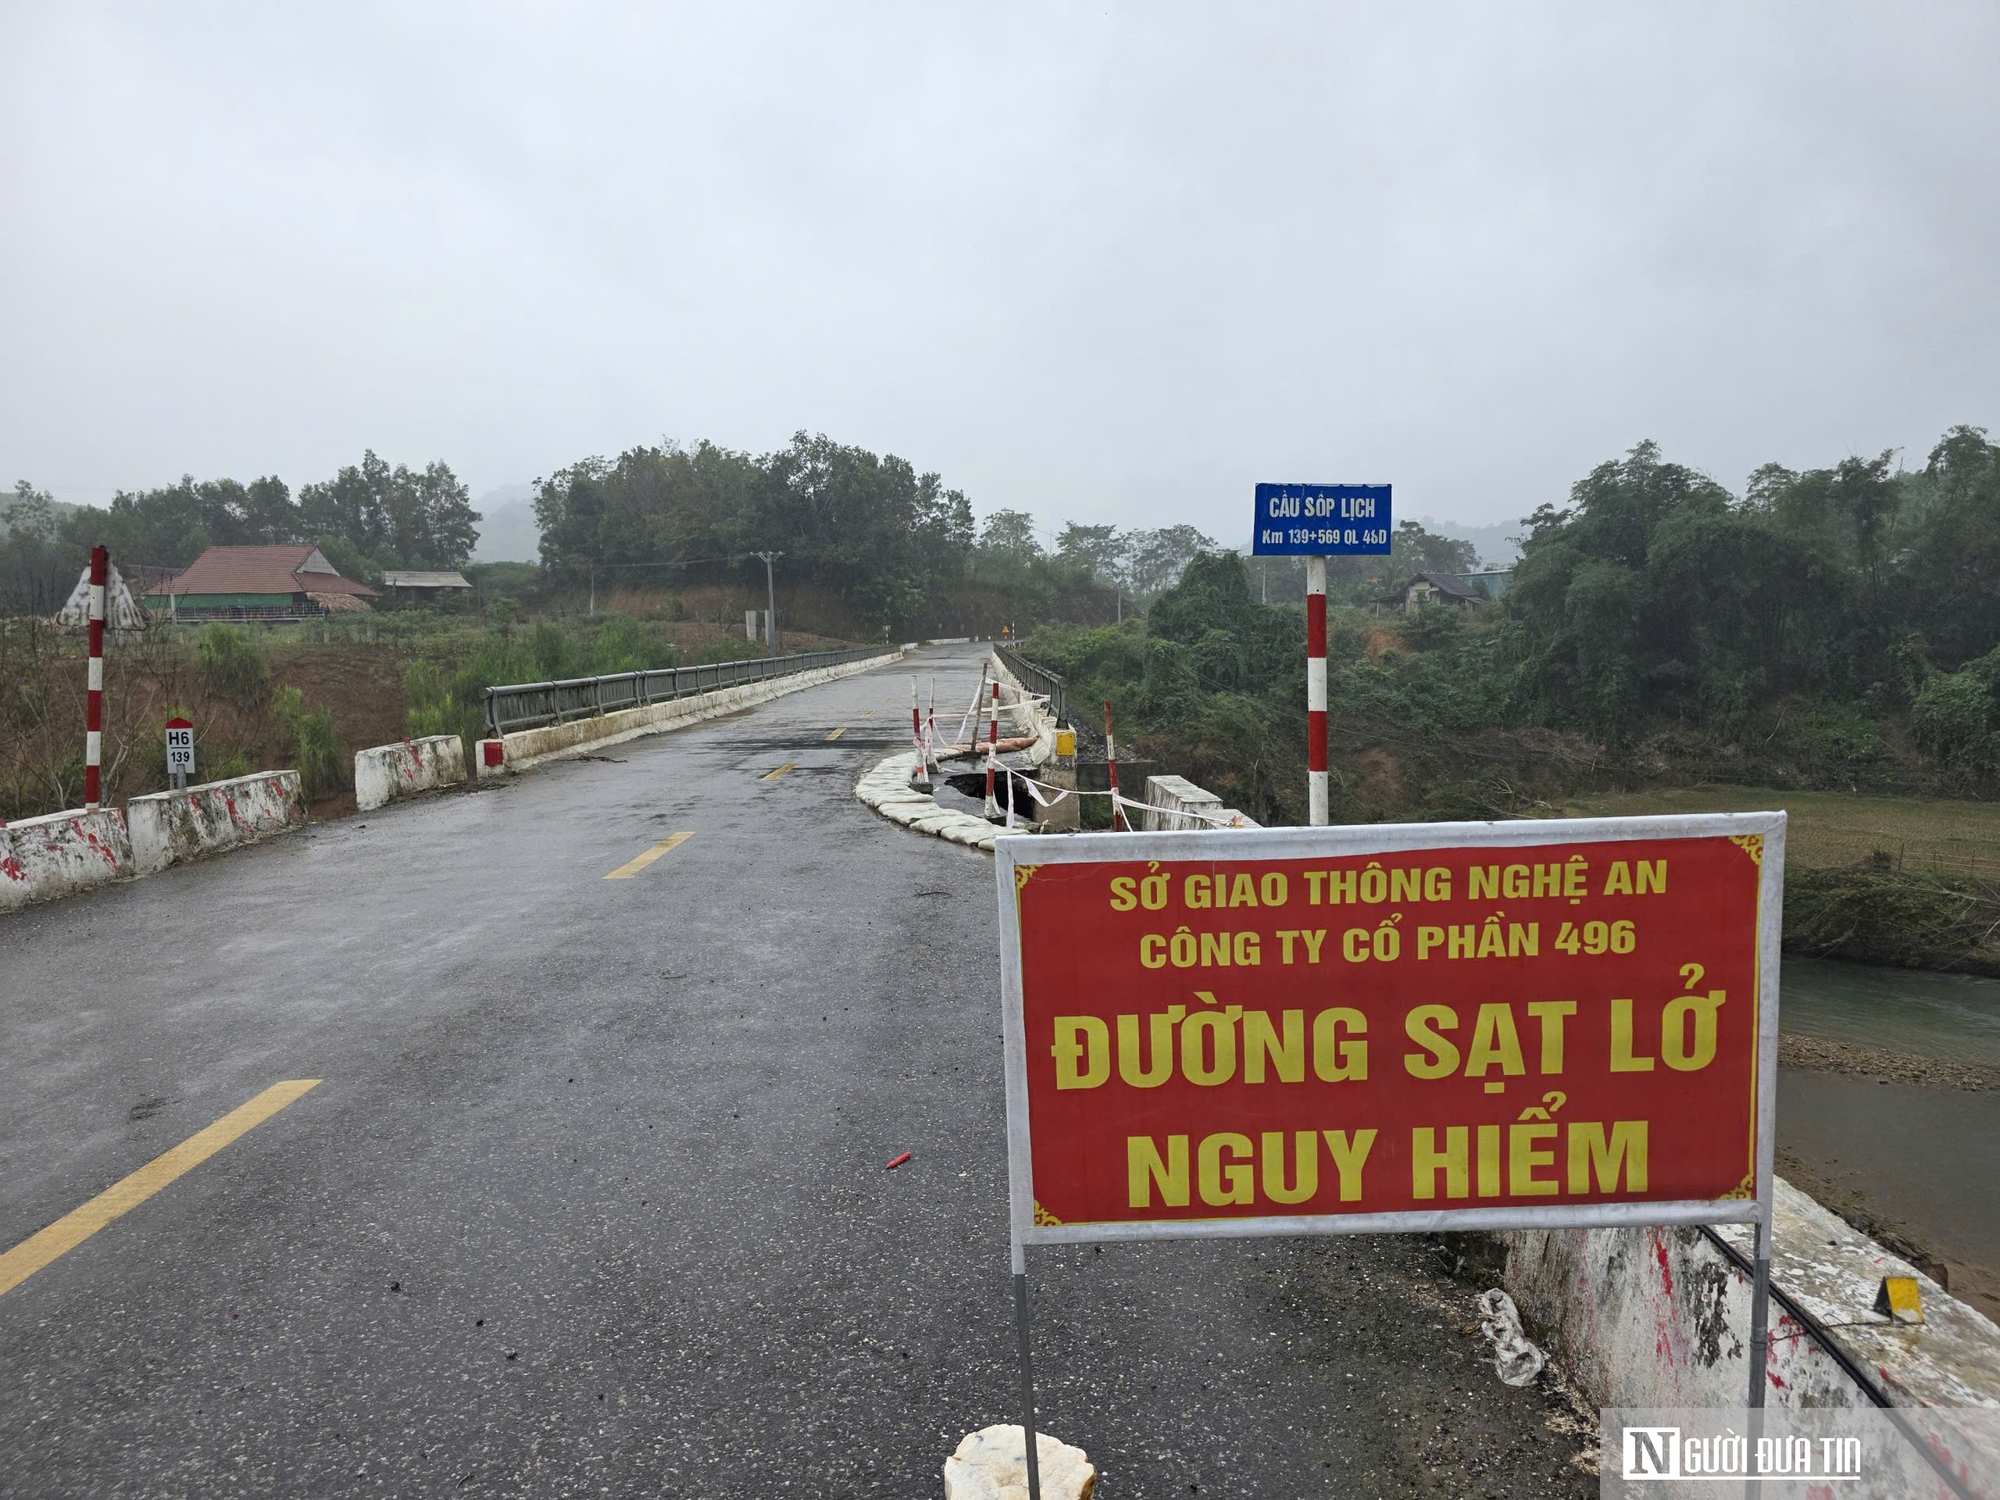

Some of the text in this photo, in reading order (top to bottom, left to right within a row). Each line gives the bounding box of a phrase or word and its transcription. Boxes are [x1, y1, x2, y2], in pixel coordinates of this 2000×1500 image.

[1269, 490, 1300, 518] CẦU
[1341, 498, 1375, 521] LỊCH
[1262, 529, 1283, 544] Km
[1288, 529, 1340, 545] 139+569
[1344, 529, 1359, 545] QL
[168, 731, 190, 746] H6
[171, 751, 190, 763] 139
[1110, 855, 1667, 912] SỞ GIAO THÔNG NGHỆ AN
[1140, 911, 1636, 969] CÔNG TY CỔ PHẦN 496
[1050, 963, 1726, 1094] ĐƯỜNG SẠT LỞ
[1127, 1091, 1649, 1208] NGUY HIỂM
